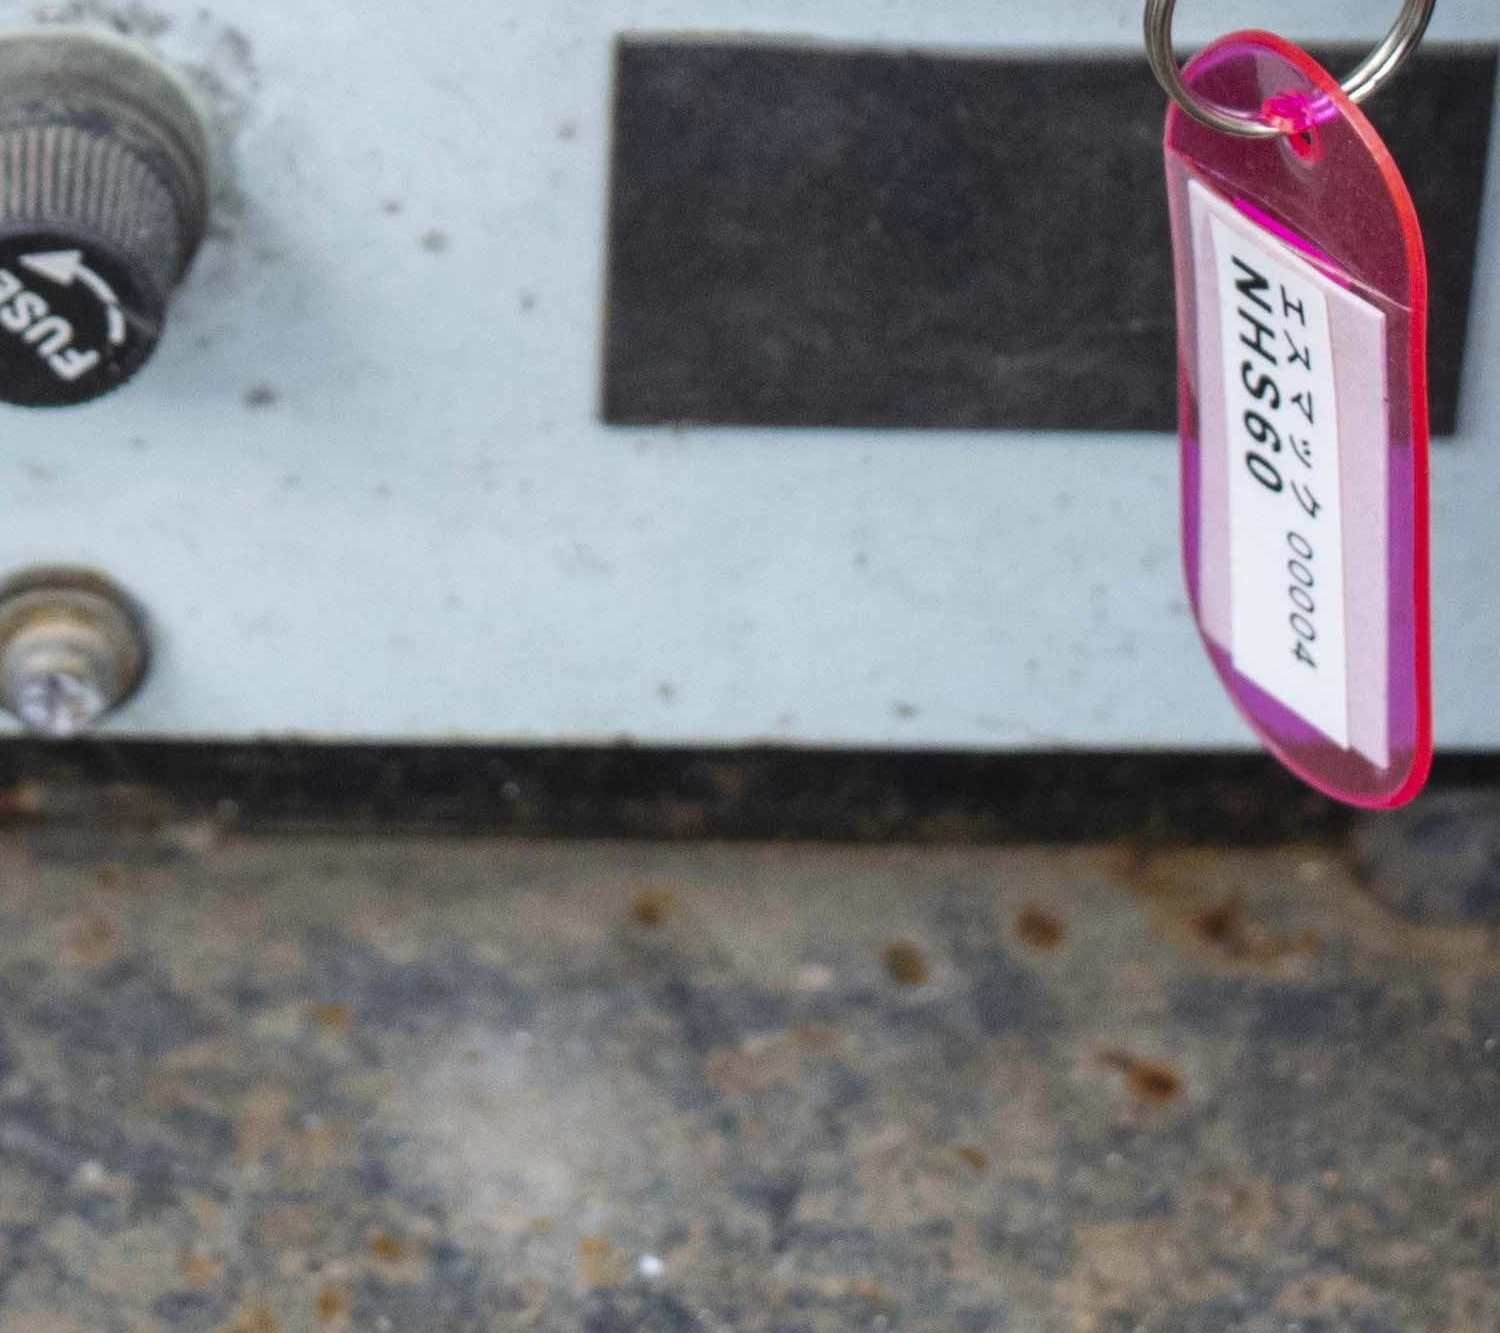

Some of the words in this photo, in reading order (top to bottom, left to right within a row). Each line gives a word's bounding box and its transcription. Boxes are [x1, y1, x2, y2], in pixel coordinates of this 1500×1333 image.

[1231, 255, 1284, 494] NHS60
[1277, 284, 1323, 519] エスマック
[1285, 530, 1318, 670] 00004
